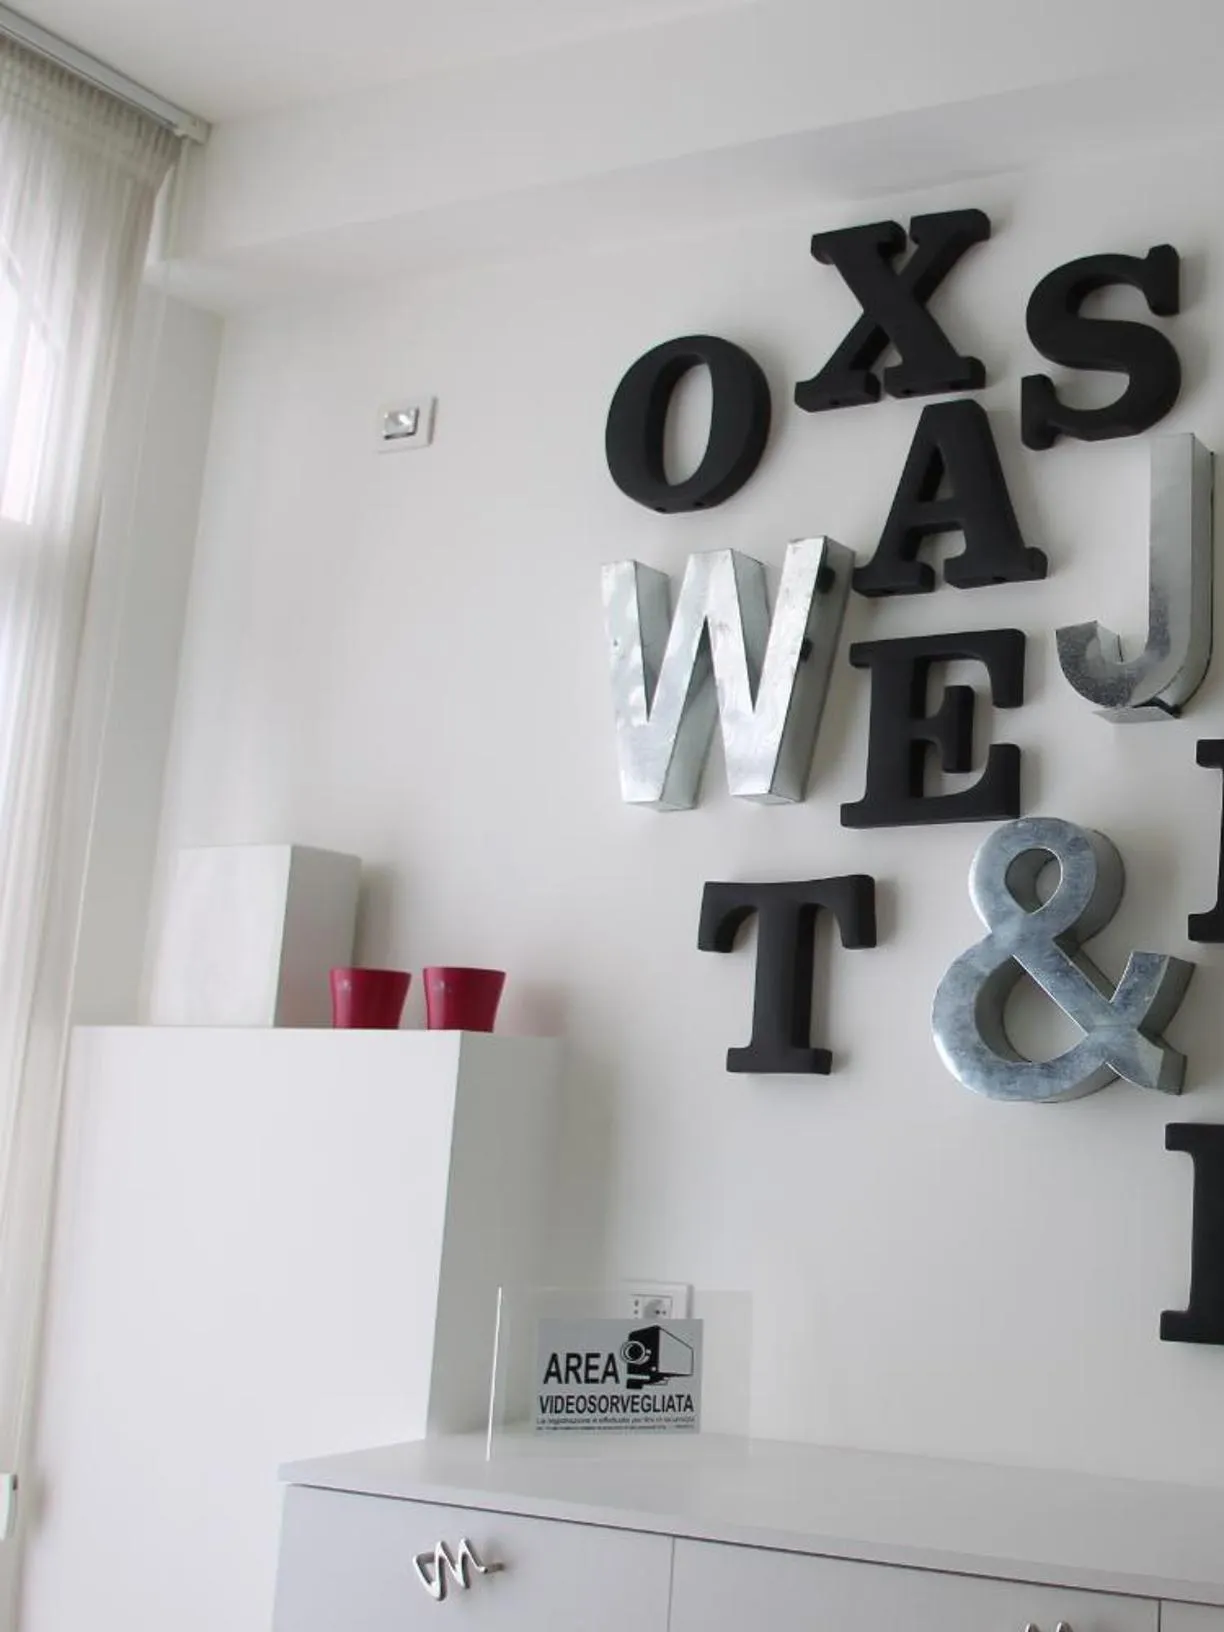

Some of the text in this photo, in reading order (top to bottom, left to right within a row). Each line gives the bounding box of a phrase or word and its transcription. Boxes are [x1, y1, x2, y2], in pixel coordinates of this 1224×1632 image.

[795, 208, 991, 413] X
[1021, 244, 1182, 450] S
[605, 335, 771, 514] O
[852, 399, 1048, 597] A
[601, 535, 856, 812] W
[1056, 432, 1214, 723] J
[840, 628, 1026, 828] E
[698, 874, 877, 1074] T
[932, 817, 1195, 1103] &
[539, 1394, 695, 1415] VIDEOSORVEGLIATA
[543, 1352, 620, 1385] AREA
